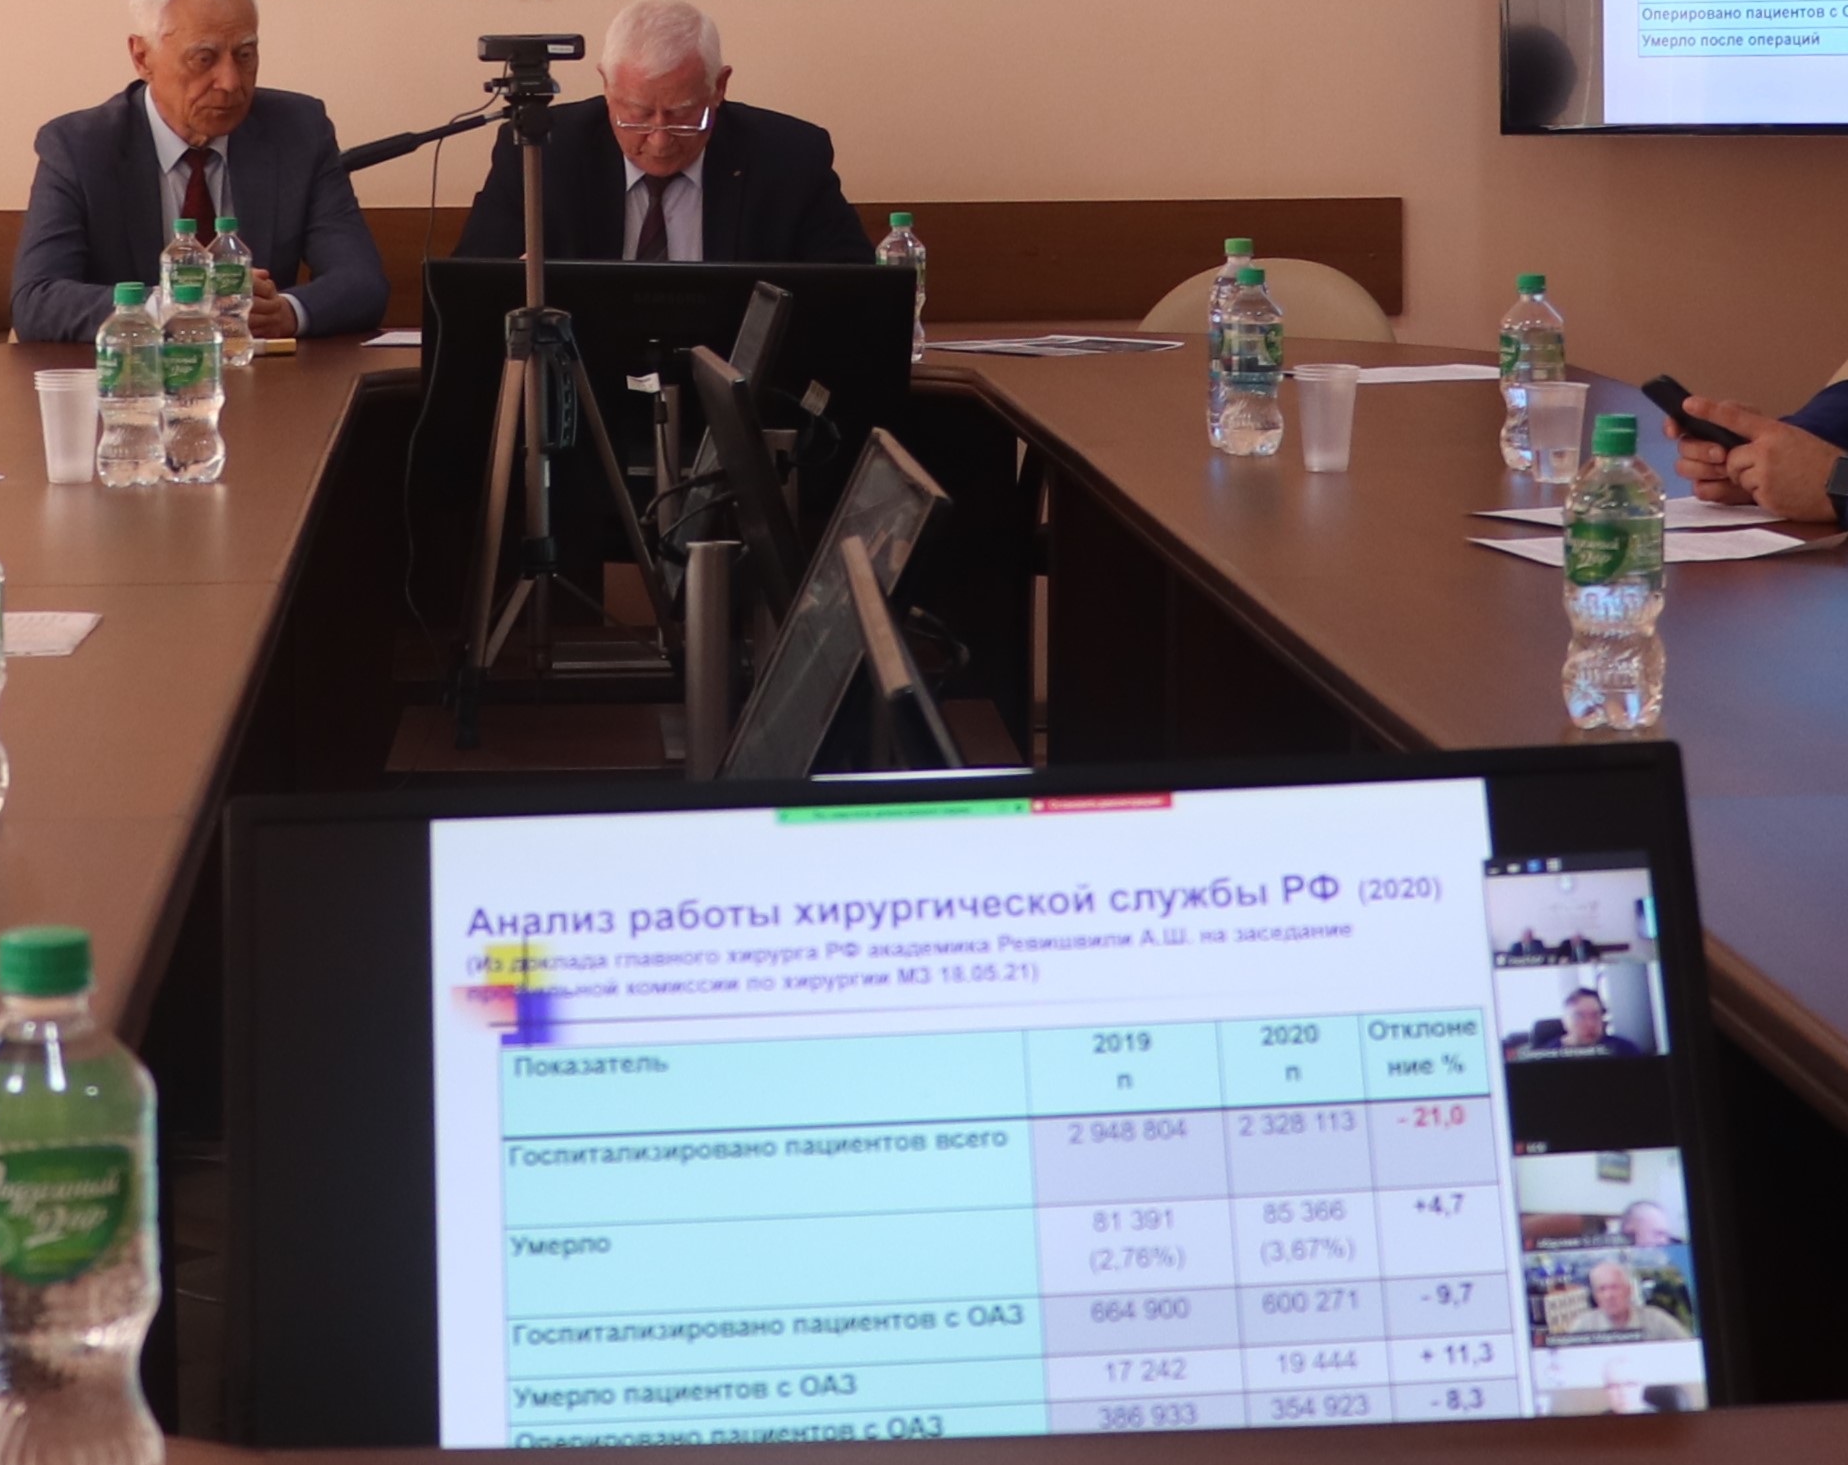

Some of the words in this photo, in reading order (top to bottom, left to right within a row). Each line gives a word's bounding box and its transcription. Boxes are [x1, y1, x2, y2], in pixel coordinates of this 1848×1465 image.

[1642, 8, 1742, 23] Оперировано
[1746, 6, 1825, 21] пациентов
[1829, 7, 1838, 18] с
[1642, 34, 1696, 49] Умерло
[1700, 34, 1744, 46] после
[1748, 31, 1820, 48] операций
[467, 907, 614, 936] Анализ
[630, 899, 780, 936] работы
[792, 884, 1095, 930] хирургической
[1108, 877, 1269, 918] службы
[1281, 873, 1341, 905] РФ
[1357, 875, 1443, 906] (2020)
[1261, 1024, 1320, 1047] 2020
[1367, 1018, 1477, 1043] Отклоне
[1093, 1032, 1152, 1055] 2019
[514, 1055, 669, 1078] Показатель
[1387, 1058, 1433, 1078] ние
[1441, 1053, 1464, 1075] %
[1238, 1115, 1254, 1137] 2
[1260, 1113, 1305, 1134] 328
[1316, 1110, 1357, 1132] 113
[1413, 1105, 1465, 1129] 21,0
[1068, 1122, 1083, 1145] 2
[1090, 1121, 1135, 1143] 948
[1142, 1118, 1187, 1142] 804
[508, 1140, 777, 1168] Госпитализировано
[785, 1133, 927, 1159] пациентов
[935, 1129, 1009, 1152] всего
[1262, 1202, 1294, 1225] 85
[1301, 1200, 1347, 1222] 366
[1413, 1193, 1465, 1219] +4,7
[1092, 1211, 1120, 1232] 81
[1130, 1209, 1174, 1231] 391
[509, 1234, 612, 1259] Умерло
[1259, 1238, 1356, 1267] (3,67%)
[1089, 1246, 1186, 1275] (2,76%)
[1261, 1292, 1309, 1316] 600
[1316, 1290, 1359, 1312] 271
[1436, 1283, 1474, 1308] 9,7
[1090, 1300, 1135, 1323] 664
[1143, 1297, 1191, 1321] 900
[512, 1320, 785, 1347] Госпитализировано
[792, 1310, 937, 1337] пациентов
[945, 1310, 960, 1327] с
[967, 1304, 1025, 1327] ОАЗ
[1278, 1353, 1305, 1375] 19
[1311, 1351, 1358, 1373] 444
[1444, 1341, 1495, 1367] 11,3
[1105, 1362, 1132, 1383] 17
[1141, 1358, 1187, 1381] 242
[513, 1385, 616, 1412] Умерло
[623, 1381, 768, 1405] пациентов
[777, 1381, 792, 1397] с
[799, 1374, 858, 1397] ОАЗ
[1446, 1387, 1485, 1411] 8,3
[1098, 1406, 1146, 1429] 386
[1152, 1403, 1198, 1427] 933
[1270, 1397, 1317, 1421] 354
[1324, 1395, 1370, 1418] 923
